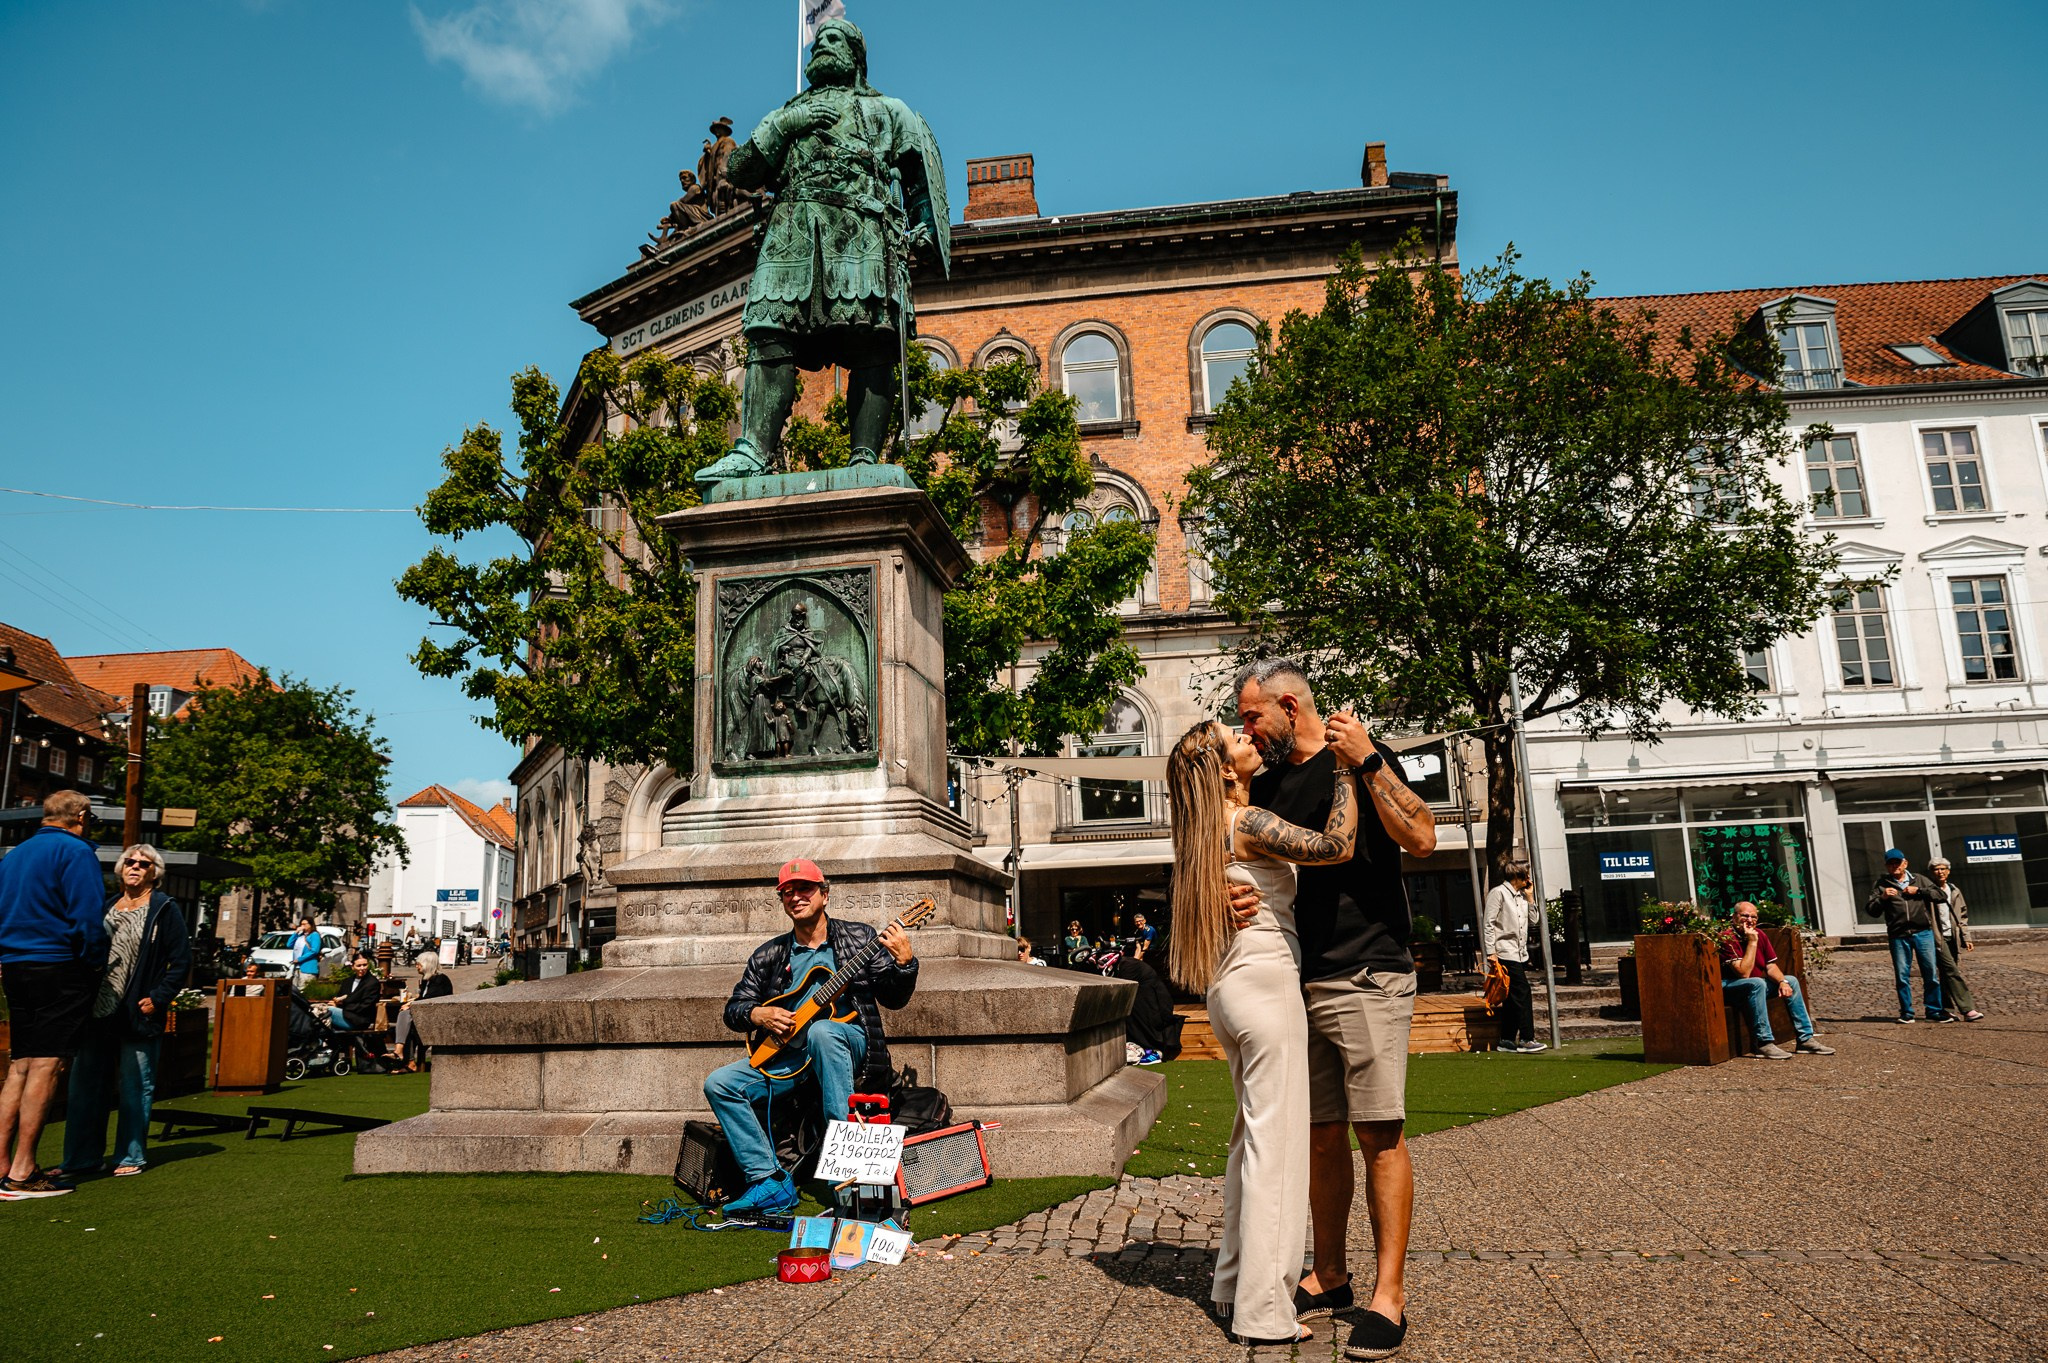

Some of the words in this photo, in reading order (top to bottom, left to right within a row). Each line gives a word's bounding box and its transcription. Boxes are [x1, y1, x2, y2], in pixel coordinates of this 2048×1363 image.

[621, 328, 645, 350] SCT
[650, 301, 705, 337] CLEMENS
[711, 281, 749, 309] GAAR
[1967, 840, 1988, 851] TIL
[1988, 838, 2017, 850] LEJE
[1602, 857, 1622, 868] TIL
[1623, 856, 1650, 867] LEJE
[449, 889, 466, 897] LEJE
[828, 1142, 896, 1159] 21960702
[820, 1158, 859, 1178] Mange
[864, 1161, 895, 1177] Tak!
[870, 1237, 895, 1254] 100
